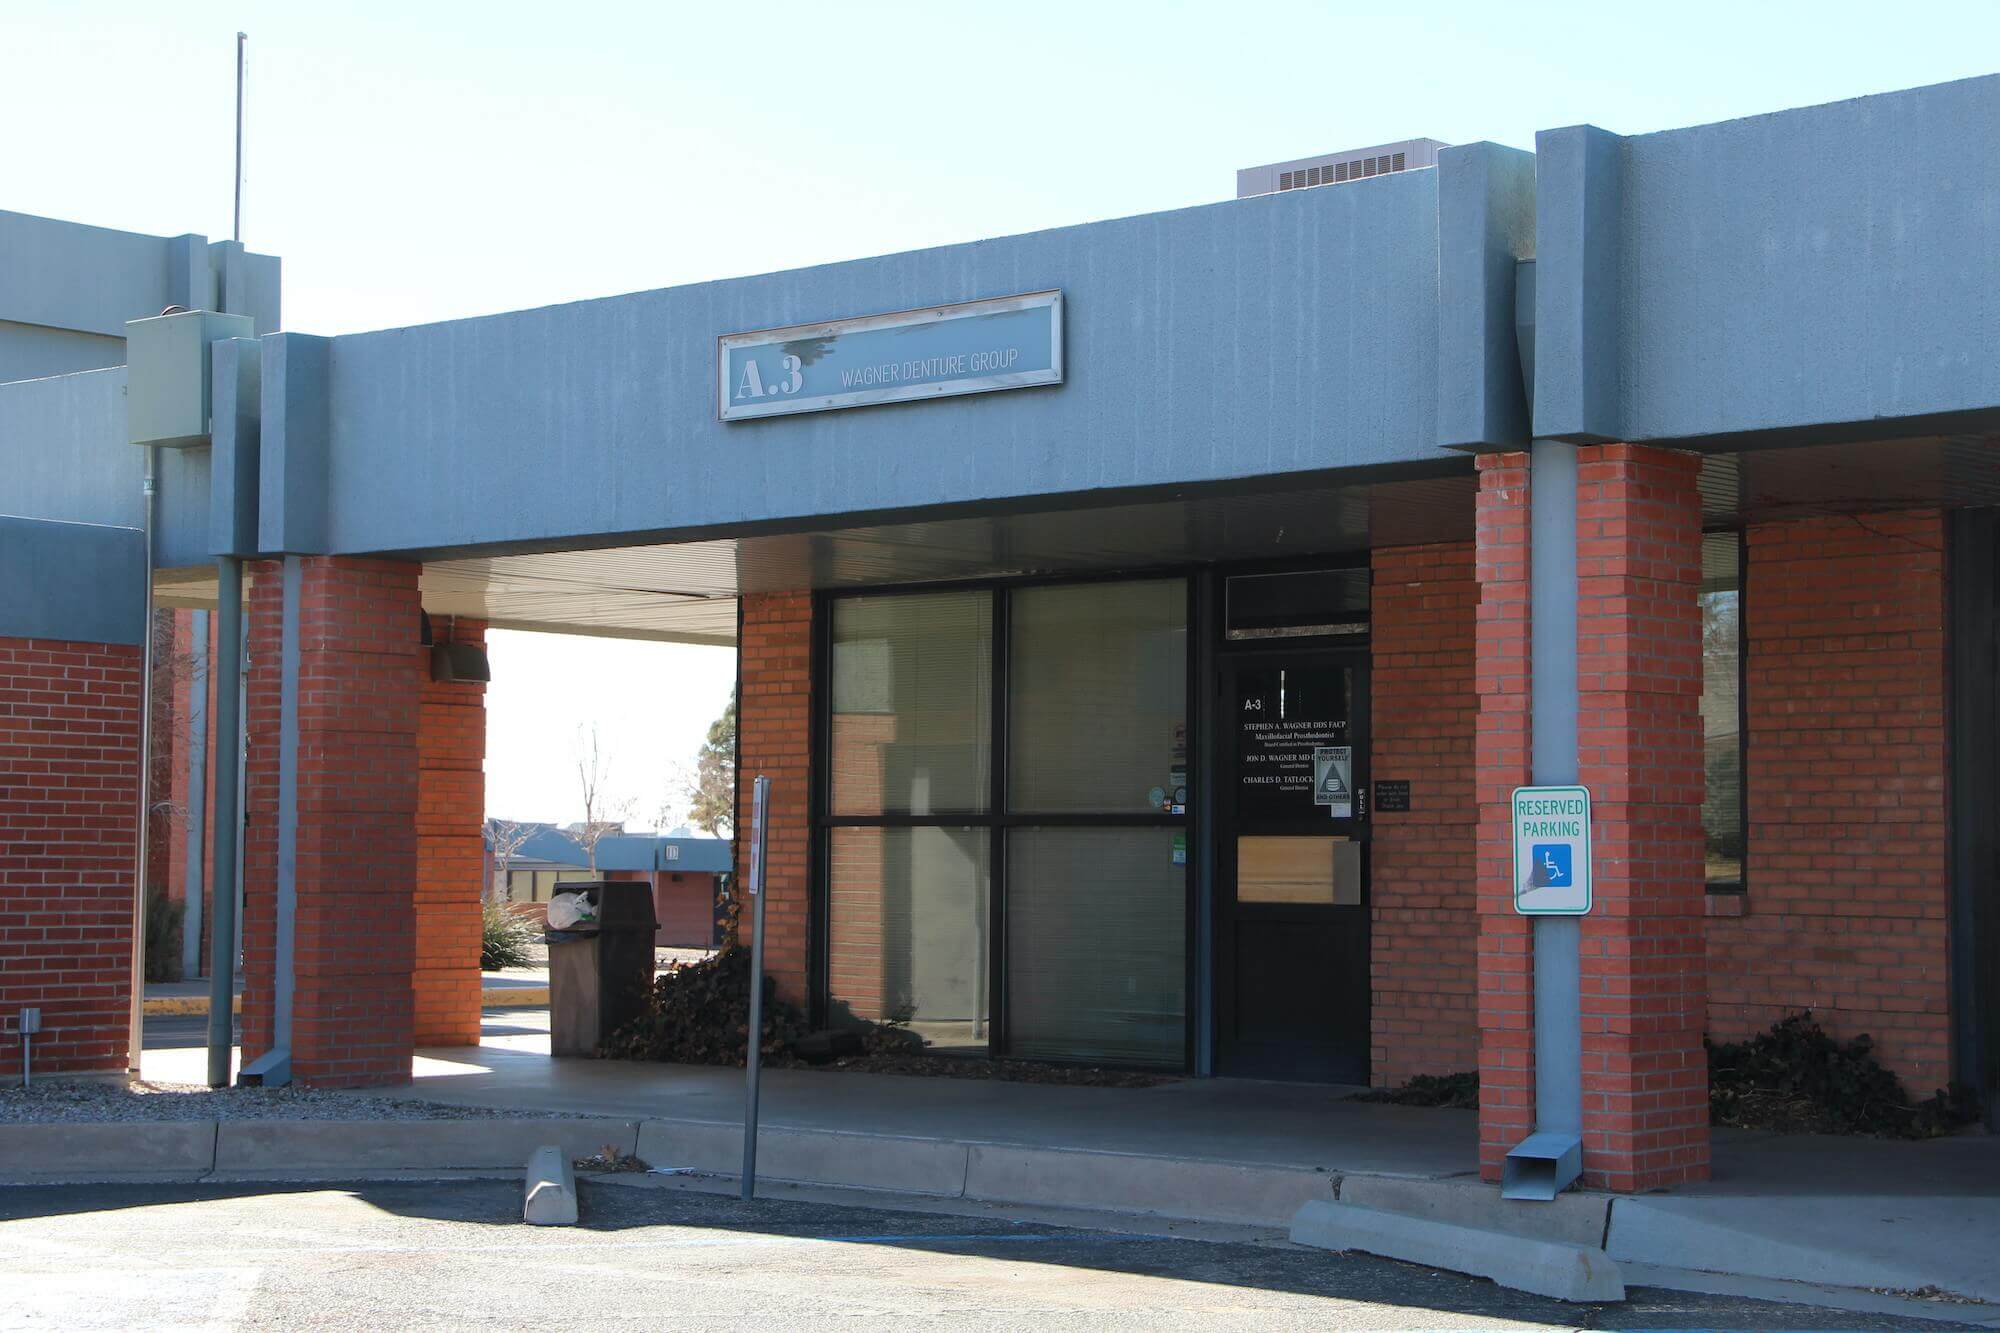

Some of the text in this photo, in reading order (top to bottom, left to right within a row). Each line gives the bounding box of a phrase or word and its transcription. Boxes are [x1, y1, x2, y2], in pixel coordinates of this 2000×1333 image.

[841, 348, 1019, 389] WAGNER DENTURE GROUP
[735, 354, 804, 400] A.3
[1244, 699, 1261, 710] A-3
[1313, 721, 1327, 729] DDS
[1328, 720, 1346, 729] FACP
[1255, 732, 1293, 740] Maxillofacial
[1246, 754, 1259, 762] JON
[1243, 776, 1274, 784] CHARLES
[1284, 776, 1314, 784] TATLOCK
[1518, 800, 1584, 816] RESERVED
[1523, 821, 1580, 837] PARKING
